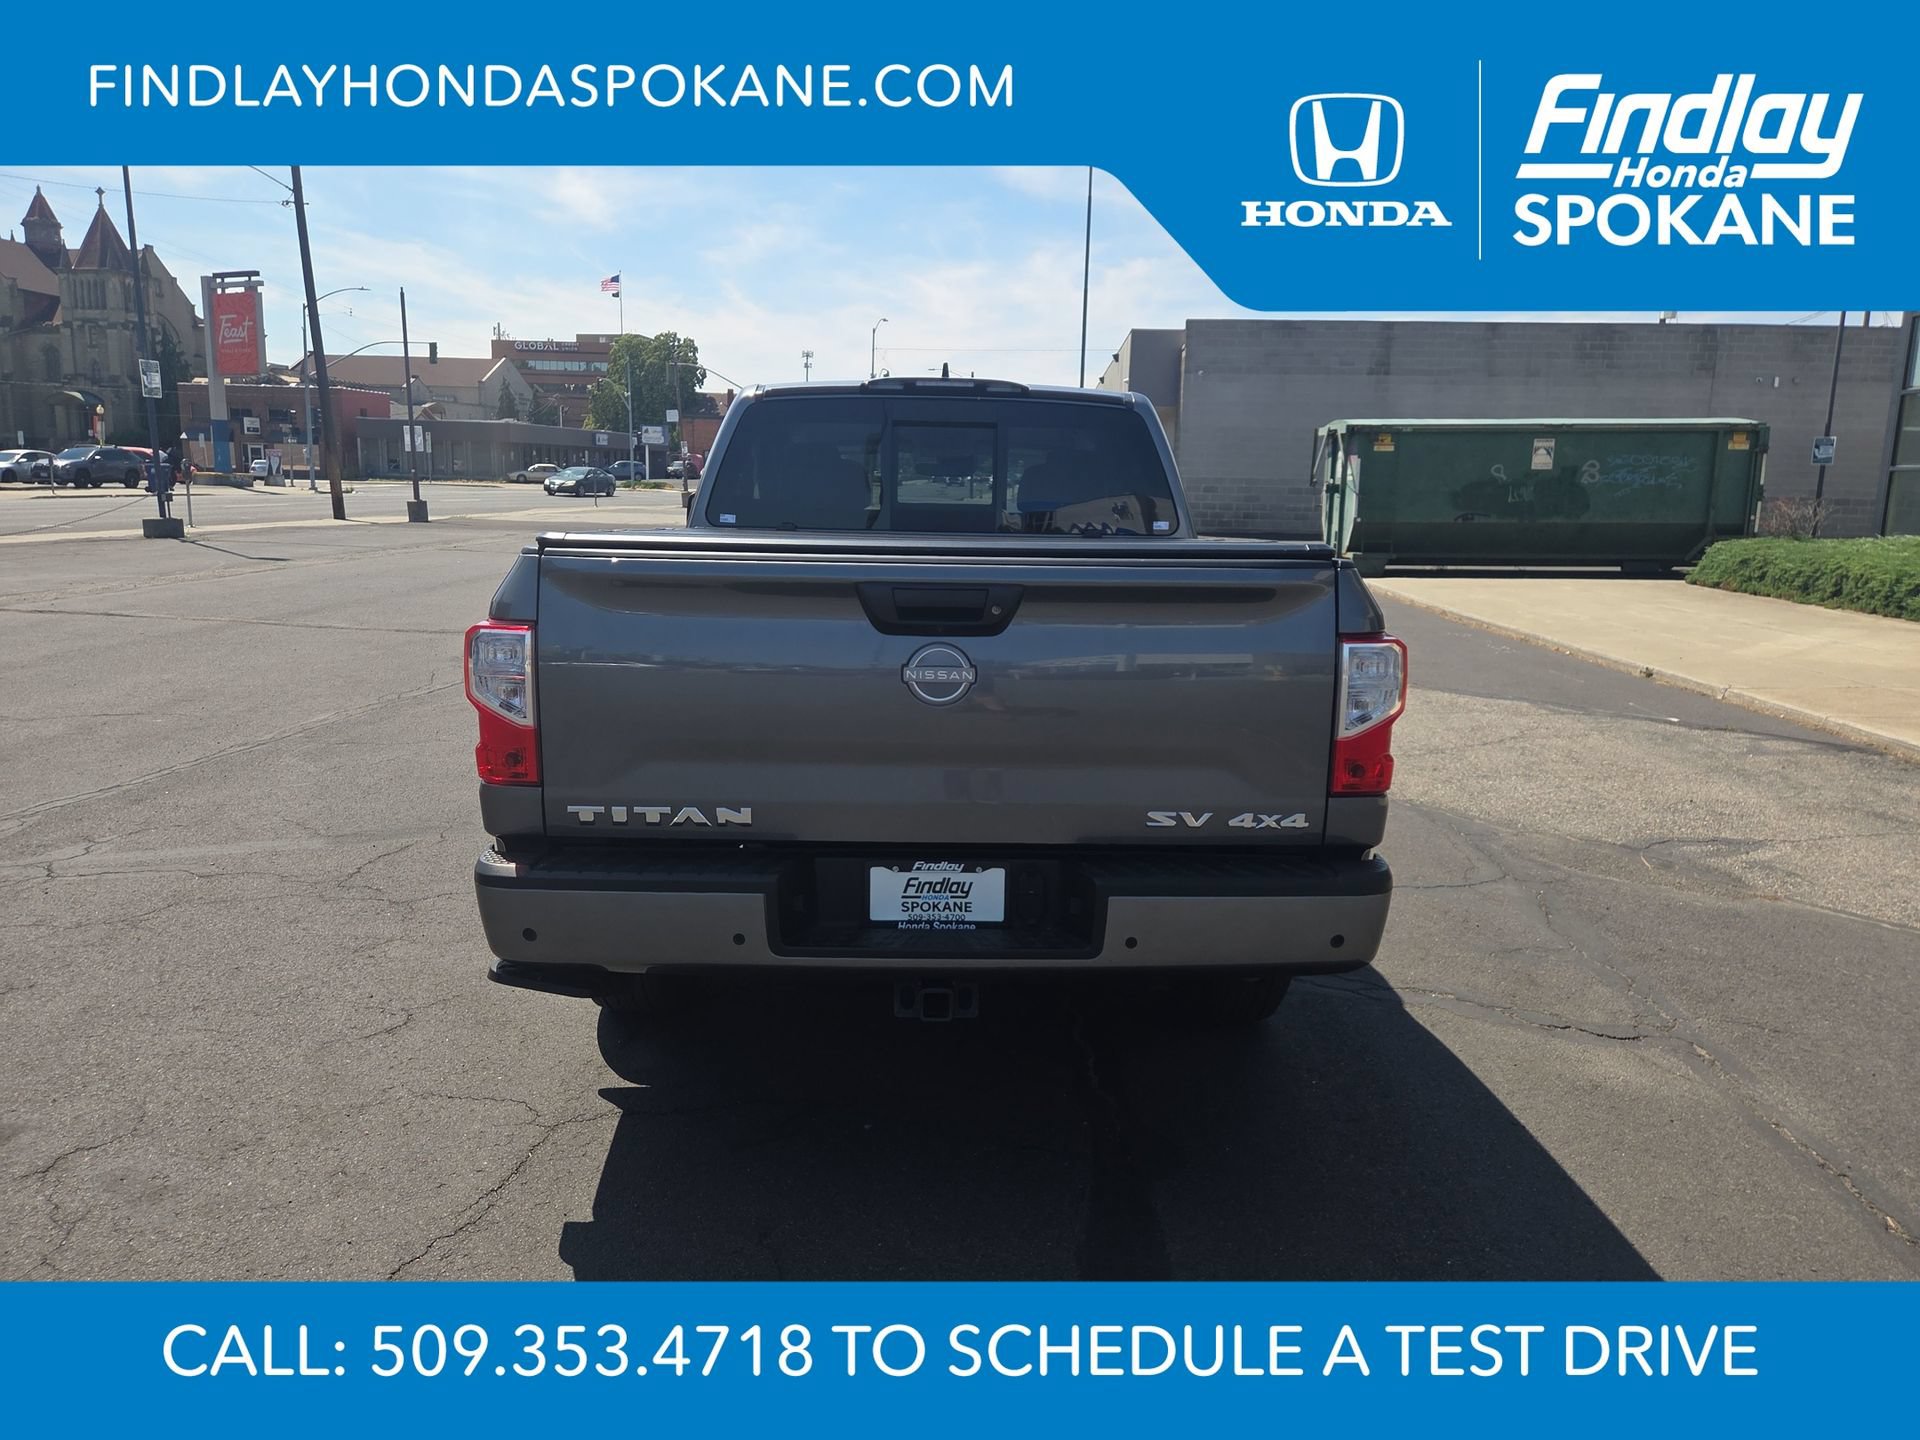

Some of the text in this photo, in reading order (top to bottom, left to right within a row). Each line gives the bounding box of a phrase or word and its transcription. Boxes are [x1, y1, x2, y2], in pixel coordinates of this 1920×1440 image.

[218, 314, 253, 345] Feast
[514, 341, 559, 351] GLOBAL
[906, 670, 973, 680] NISSAN
[567, 805, 752, 826] TITAN
[1145, 811, 1214, 828] SV
[912, 861, 965, 873] Findlay
[902, 877, 973, 899] Findlay
[901, 901, 973, 913] SPOKANE
[907, 913, 966, 921] 509-353-4700
